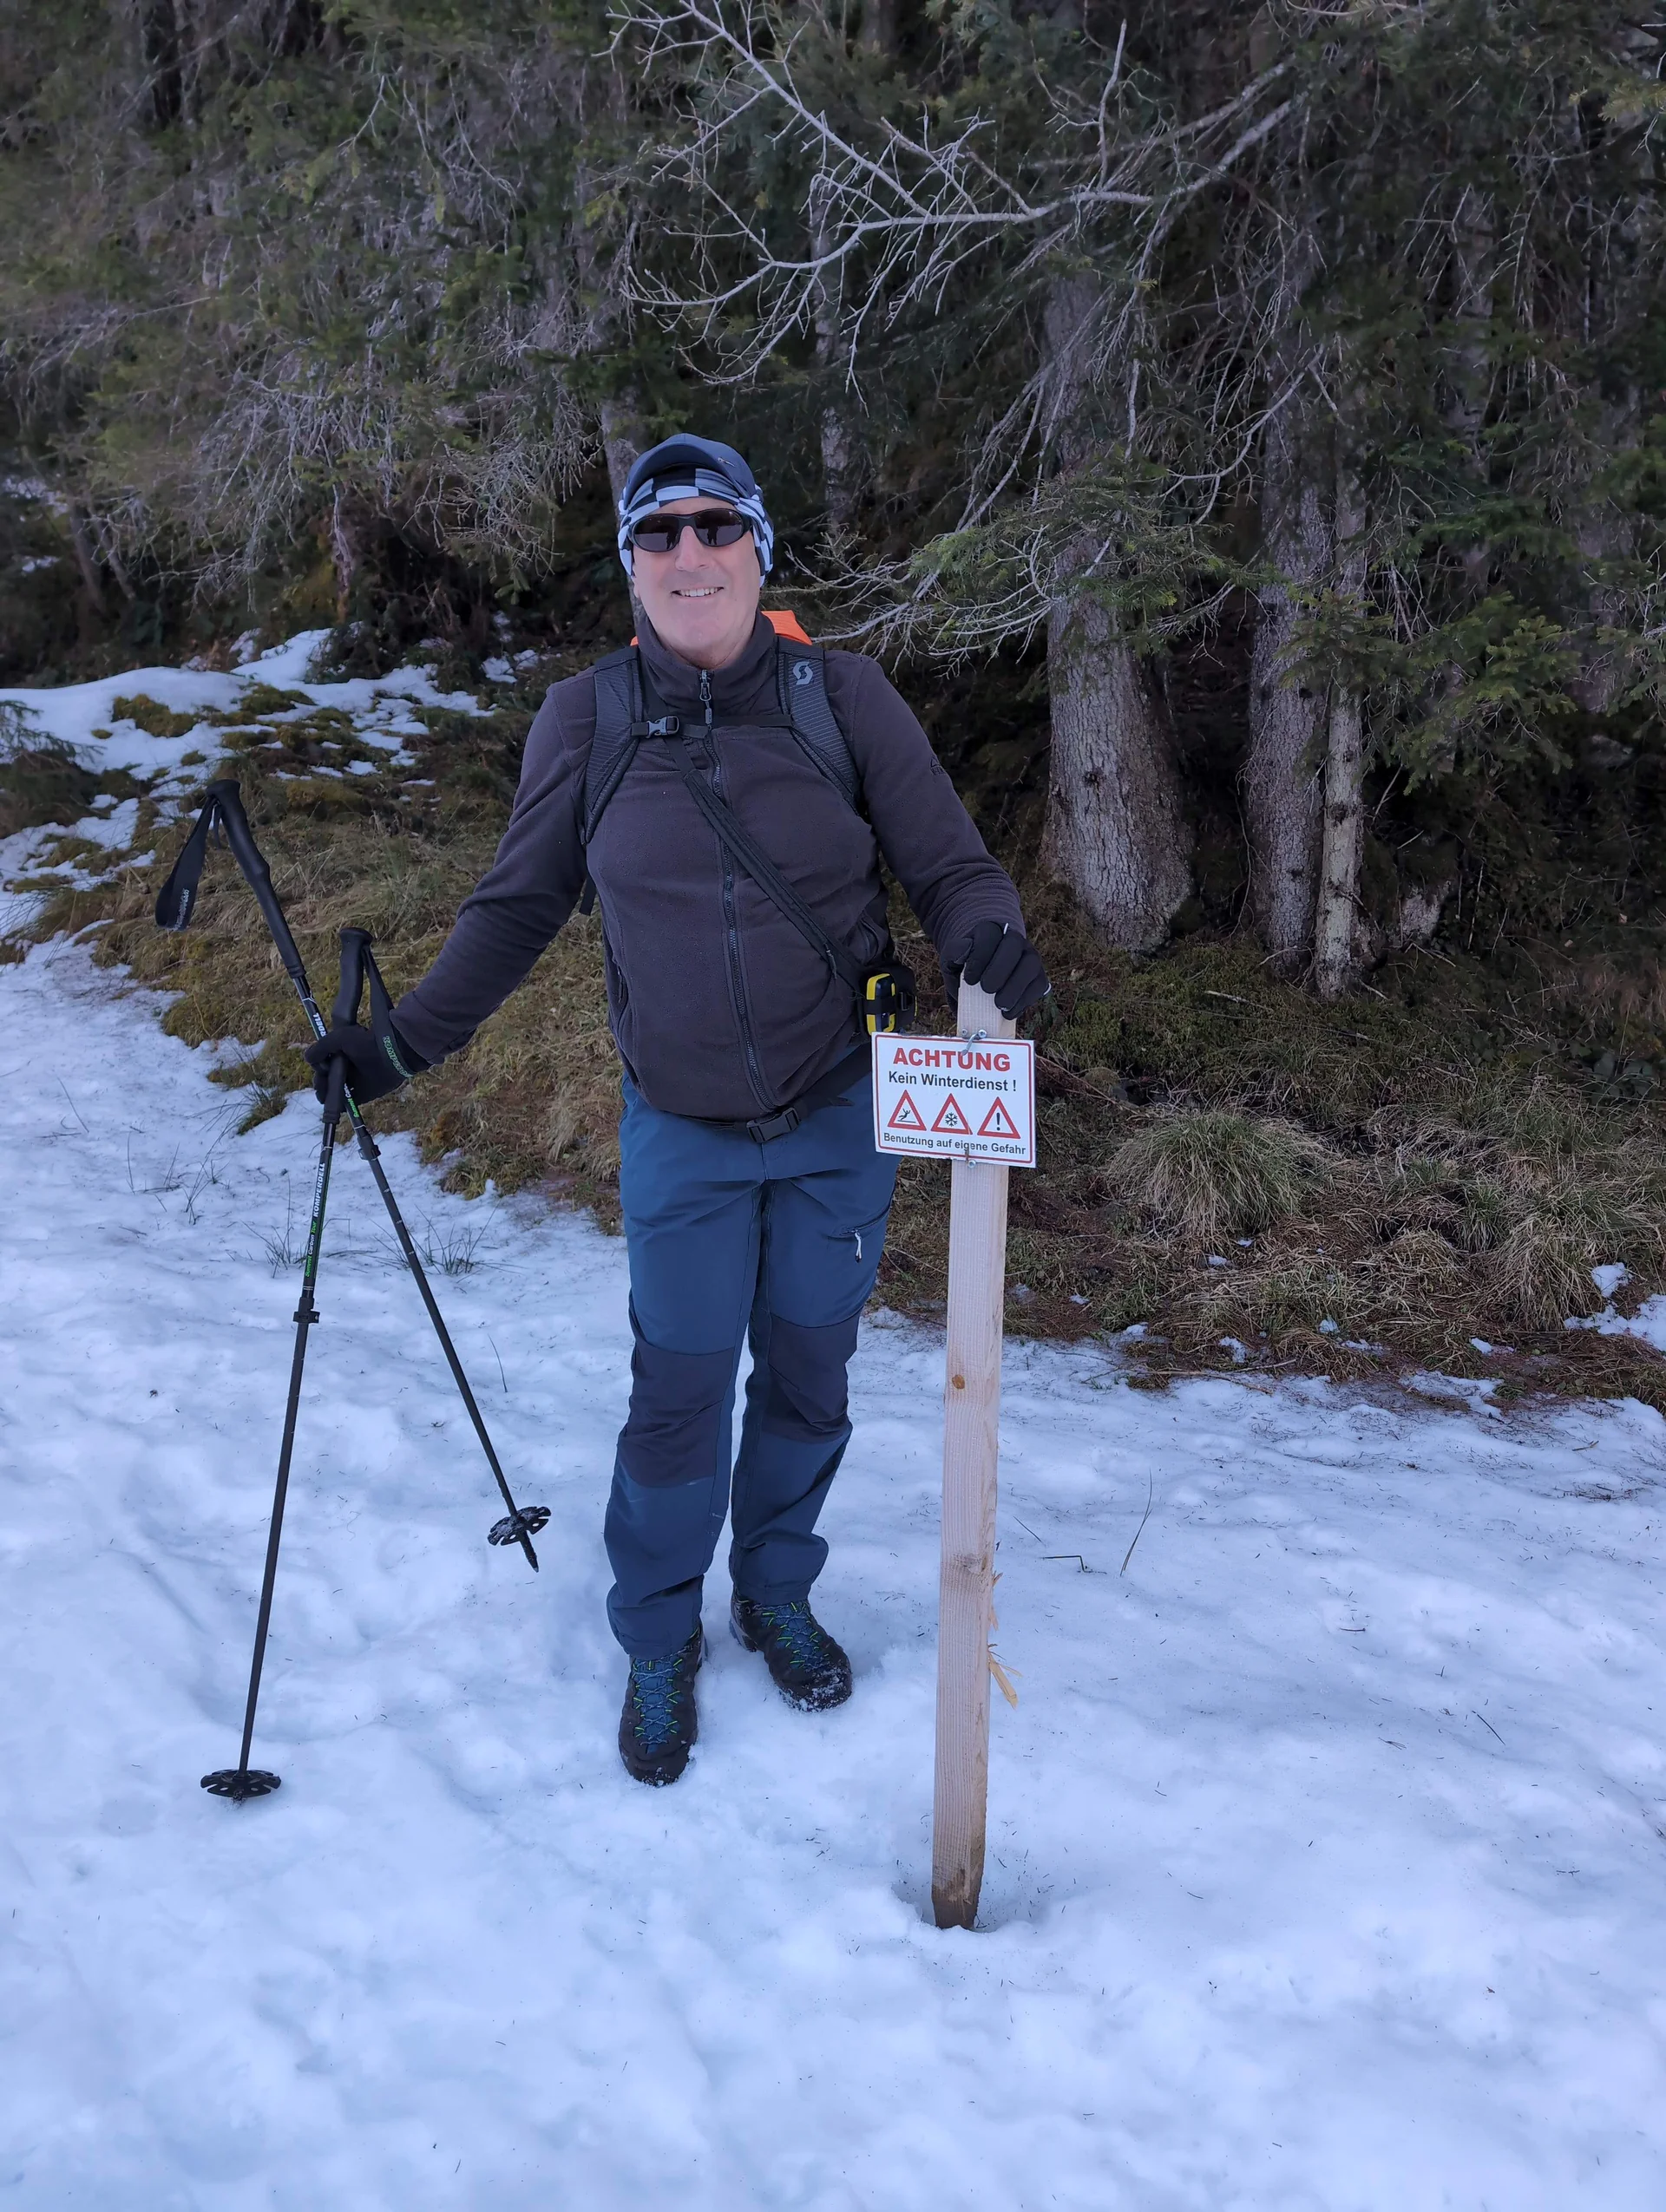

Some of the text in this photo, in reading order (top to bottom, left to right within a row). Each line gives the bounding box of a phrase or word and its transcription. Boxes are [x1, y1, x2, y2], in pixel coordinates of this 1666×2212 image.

[893, 1048, 1011, 1071] ACHTUNG
[889, 1071, 917, 1085] Kein
[921, 1073, 1008, 1091] Winterdienst
[348, 1098, 359, 1118] Summit
[883, 1133, 934, 1149] Benutzung
[954, 1142, 987, 1152] eigene
[991, 1142, 1026, 1155] Gefahr
[313, 1162, 325, 1218] KOMPERDELL
